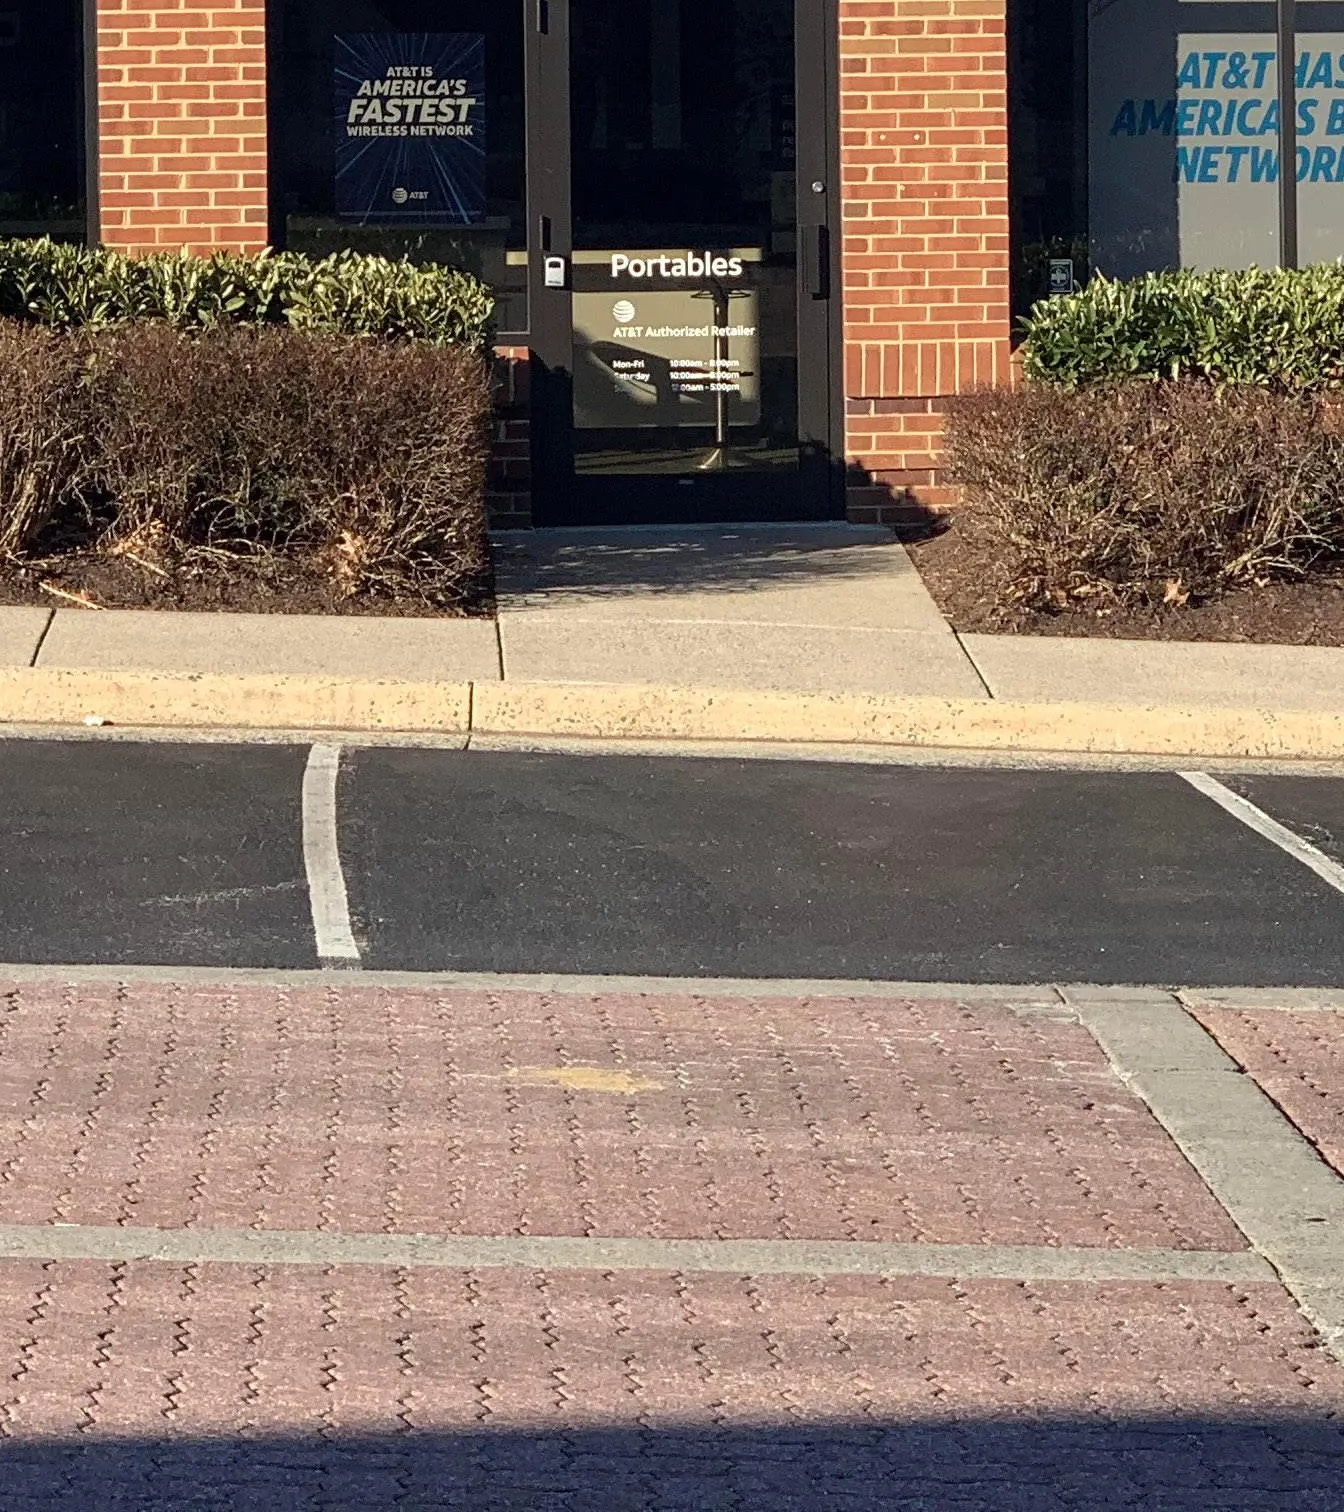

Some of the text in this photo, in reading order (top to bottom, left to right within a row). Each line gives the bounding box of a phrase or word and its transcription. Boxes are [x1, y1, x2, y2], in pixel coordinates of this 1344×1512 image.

[386, 66, 434, 78] AT&T IS
[1177, 51, 1277, 89] AT&T
[356, 79, 467, 97] AMERICA'S
[346, 97, 477, 124] FASTEST
[346, 125, 474, 137] WIRELESS NETWORK
[409, 191, 429, 200] AT&T
[611, 251, 743, 278] Portables
[613, 325, 755, 338] AT&T Authorized Retailer
[612, 359, 645, 369] Mon-Fri
